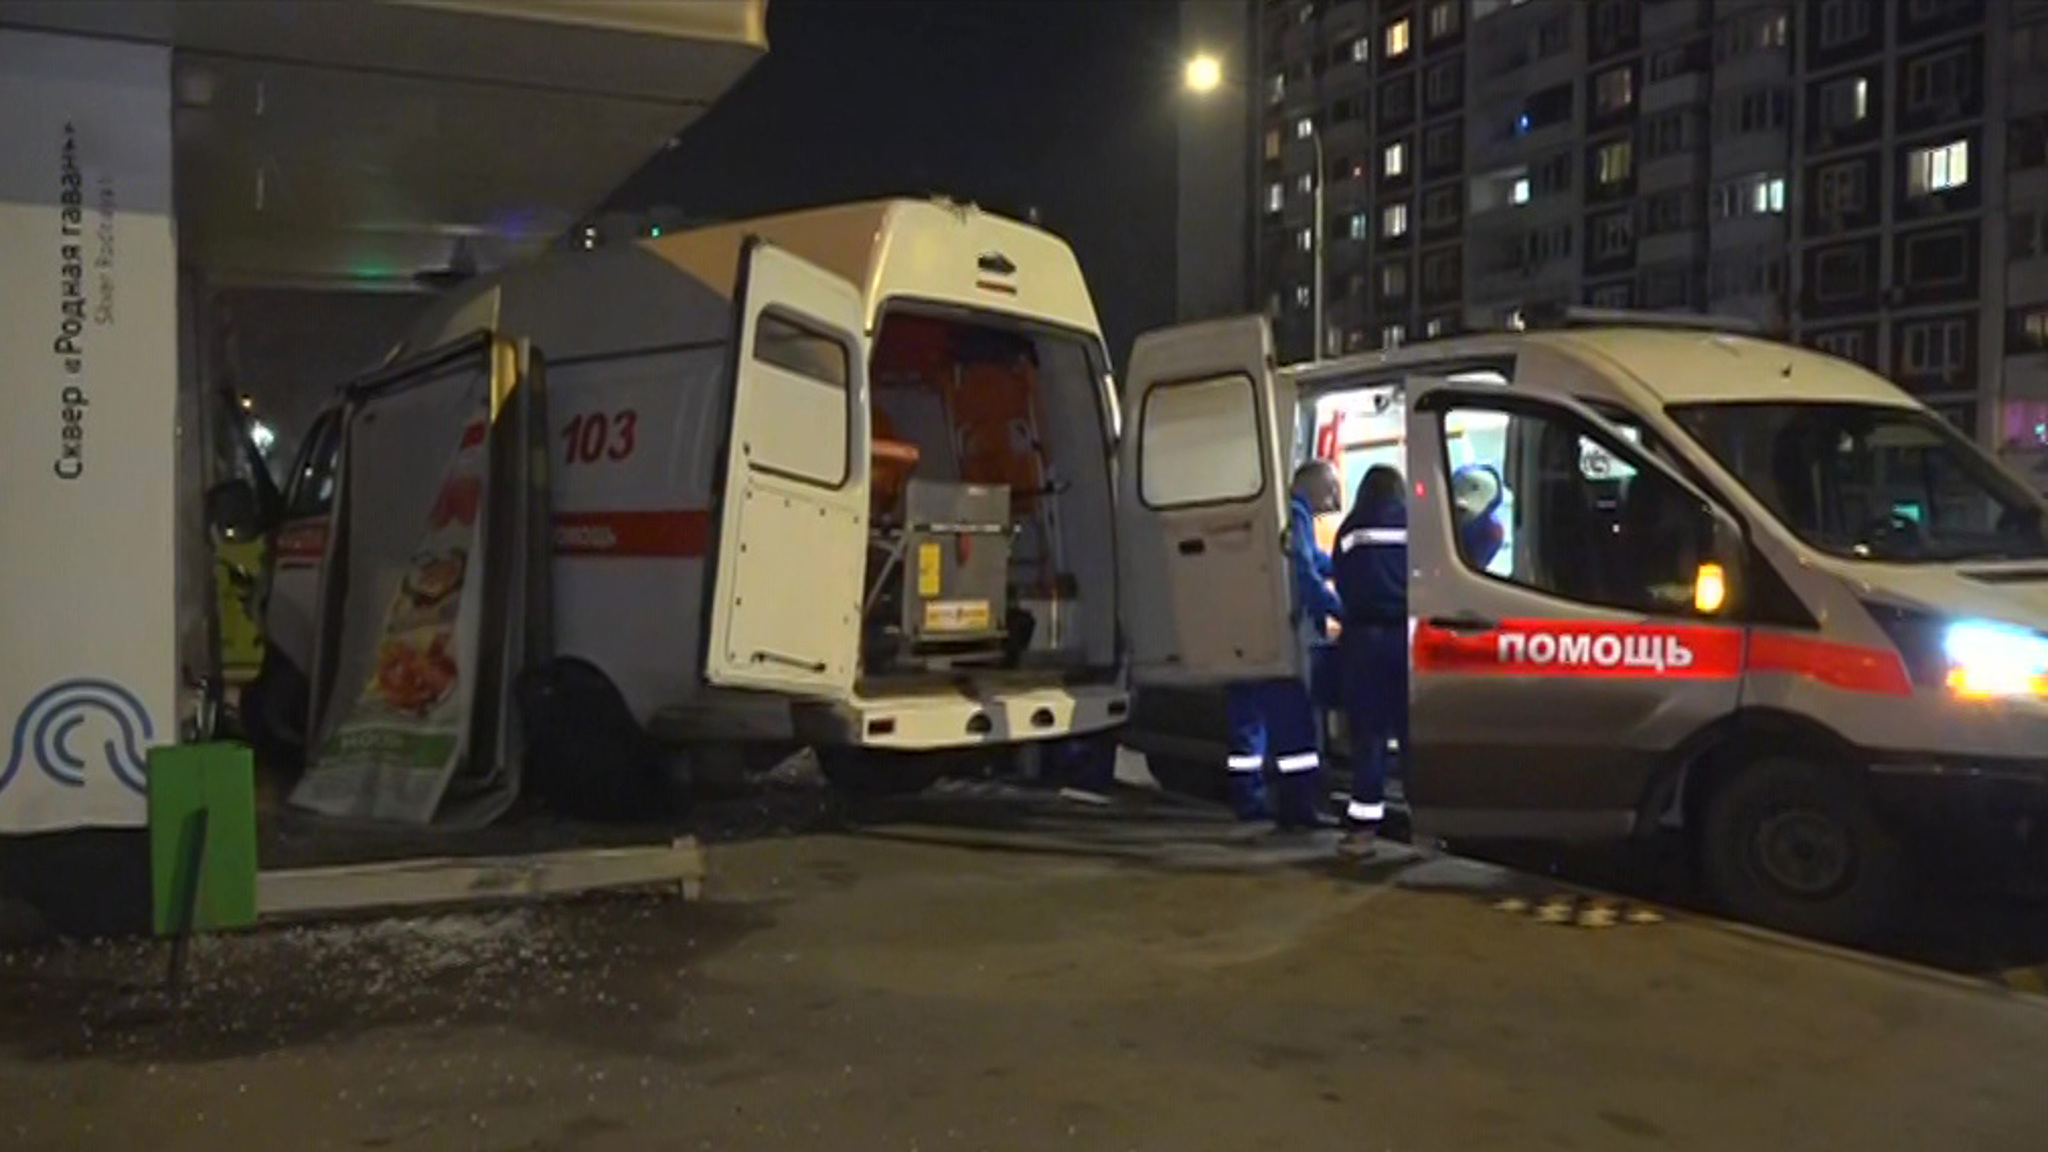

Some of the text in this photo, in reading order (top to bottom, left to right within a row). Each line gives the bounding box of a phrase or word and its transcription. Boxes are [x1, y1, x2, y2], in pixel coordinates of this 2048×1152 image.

[54, 242, 86, 374] «Родная
[54, 385, 89, 480] Сквер
[562, 409, 638, 464] 103
[1497, 632, 1693, 673] ПОМОЩЬ
